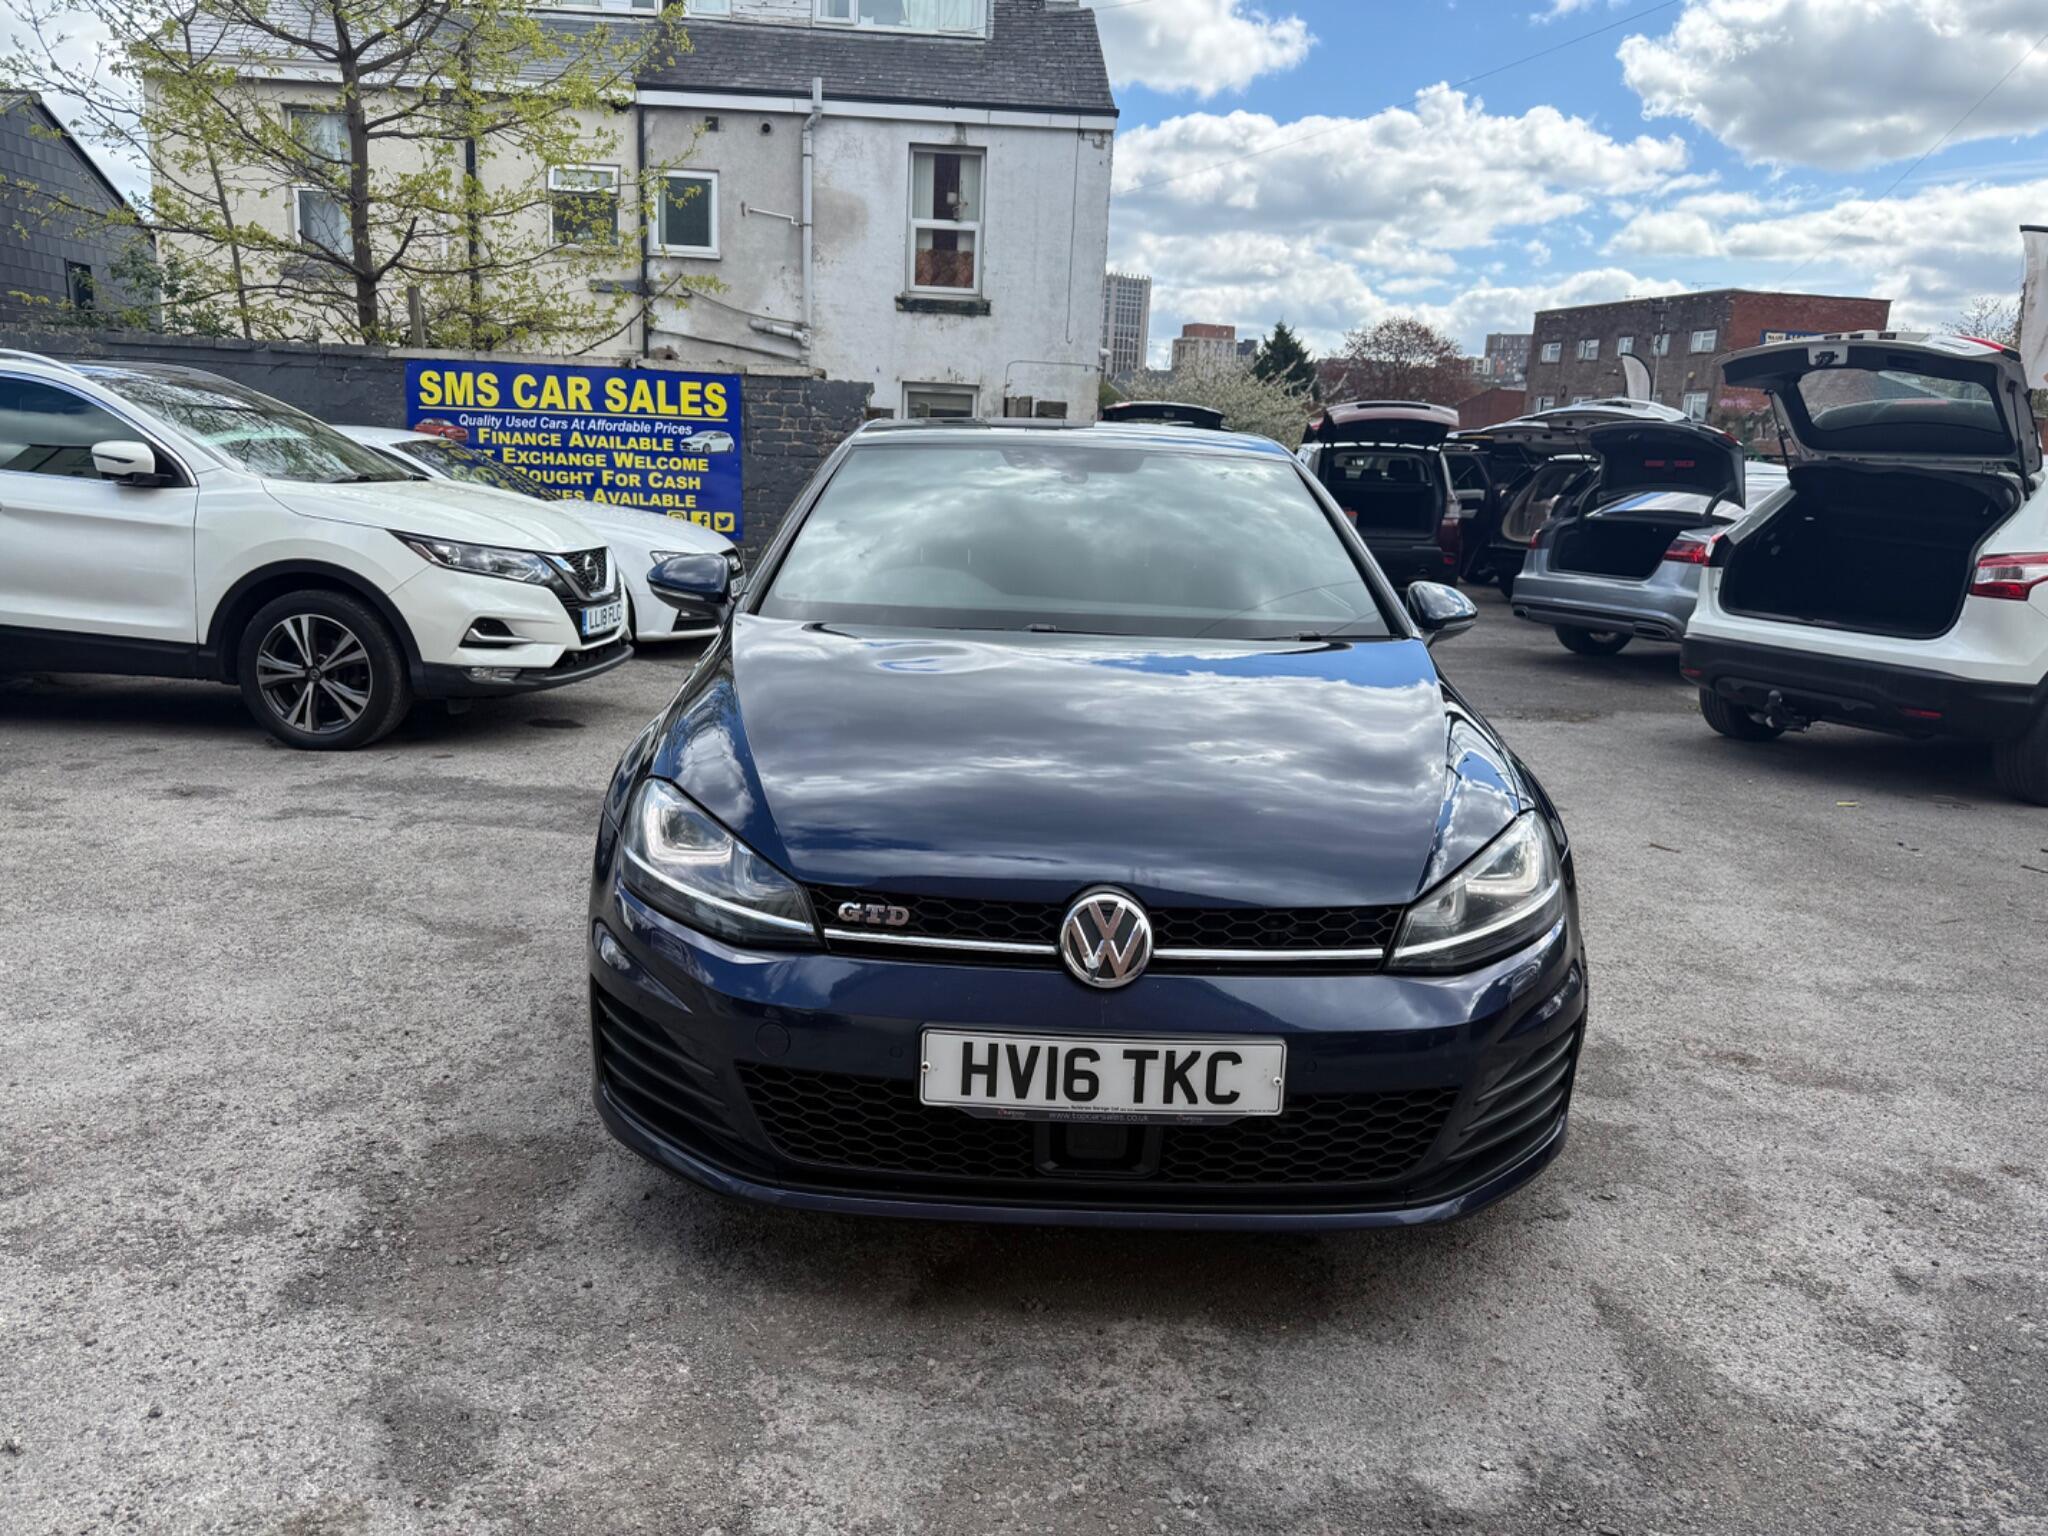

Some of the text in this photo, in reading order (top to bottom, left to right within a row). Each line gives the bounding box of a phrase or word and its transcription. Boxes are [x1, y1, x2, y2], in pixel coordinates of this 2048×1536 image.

[419, 370, 728, 417] SMS CAR SALES
[459, 413, 692, 435] Quality Used Cars At Affordable Prices
[478, 428, 674, 451] FINANCE AVAILABLE
[503, 447, 607, 467] EXCHANGE
[613, 452, 709, 472] WELCOME
[602, 470, 641, 487] FOR
[648, 472, 701, 490] CASH
[593, 488, 697, 508] AVAILABLE
[838, 902, 910, 926] GTD
[961, 1041, 1243, 1106] HV16 TKC
